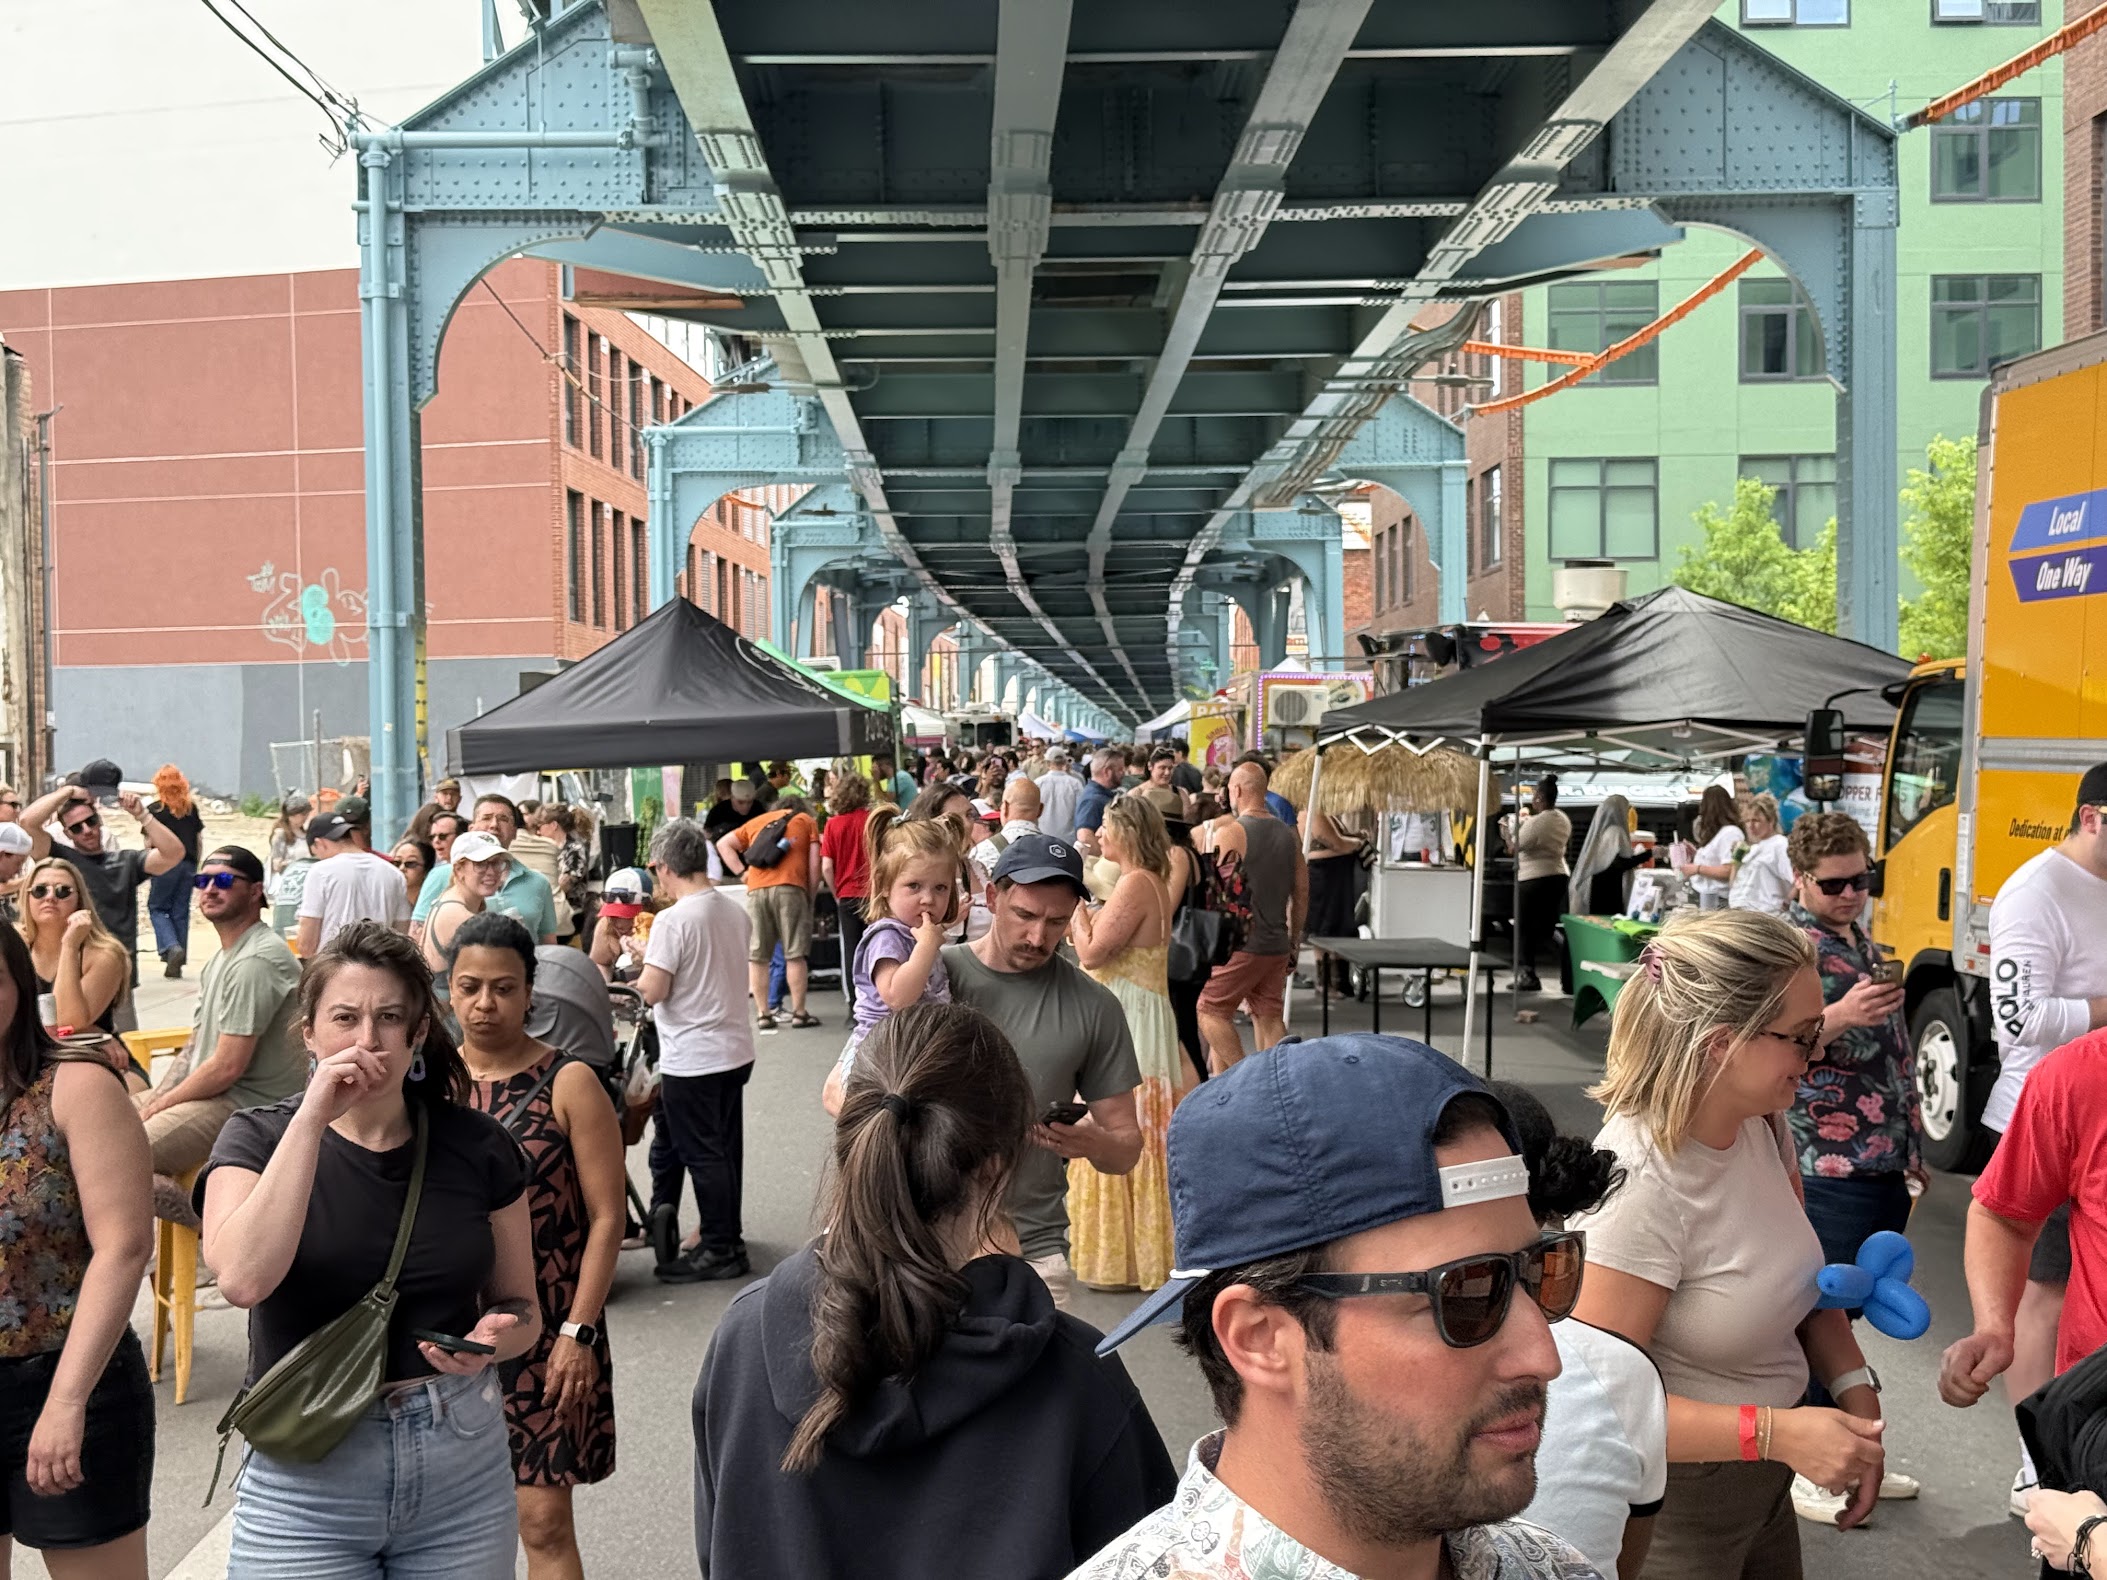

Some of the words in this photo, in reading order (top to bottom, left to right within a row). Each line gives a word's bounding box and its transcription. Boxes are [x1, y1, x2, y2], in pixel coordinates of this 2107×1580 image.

[2048, 500, 2087, 536] Local
[2036, 561, 2061, 591] One
[2061, 556, 2093, 593] Way
[2009, 818, 2052, 840] Dedication
[2053, 825, 2063, 841] at
[1995, 958, 2023, 1037] POLO
